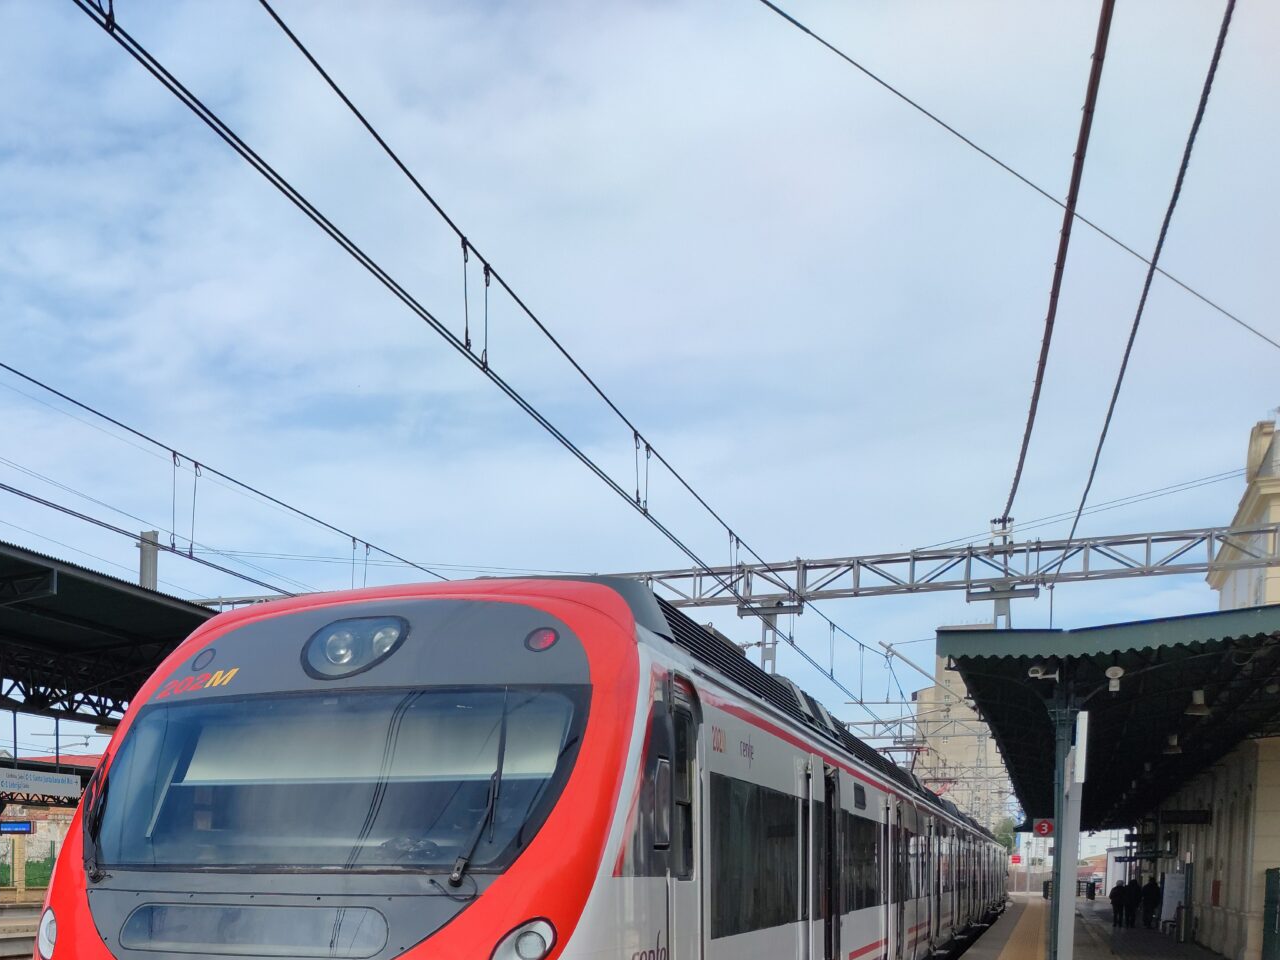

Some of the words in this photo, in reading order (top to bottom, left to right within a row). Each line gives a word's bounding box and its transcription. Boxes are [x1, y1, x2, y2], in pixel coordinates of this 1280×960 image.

[155, 667, 240, 700] 202M
[740, 733, 754, 769] renfe
[1041, 823, 1049, 834] 3
